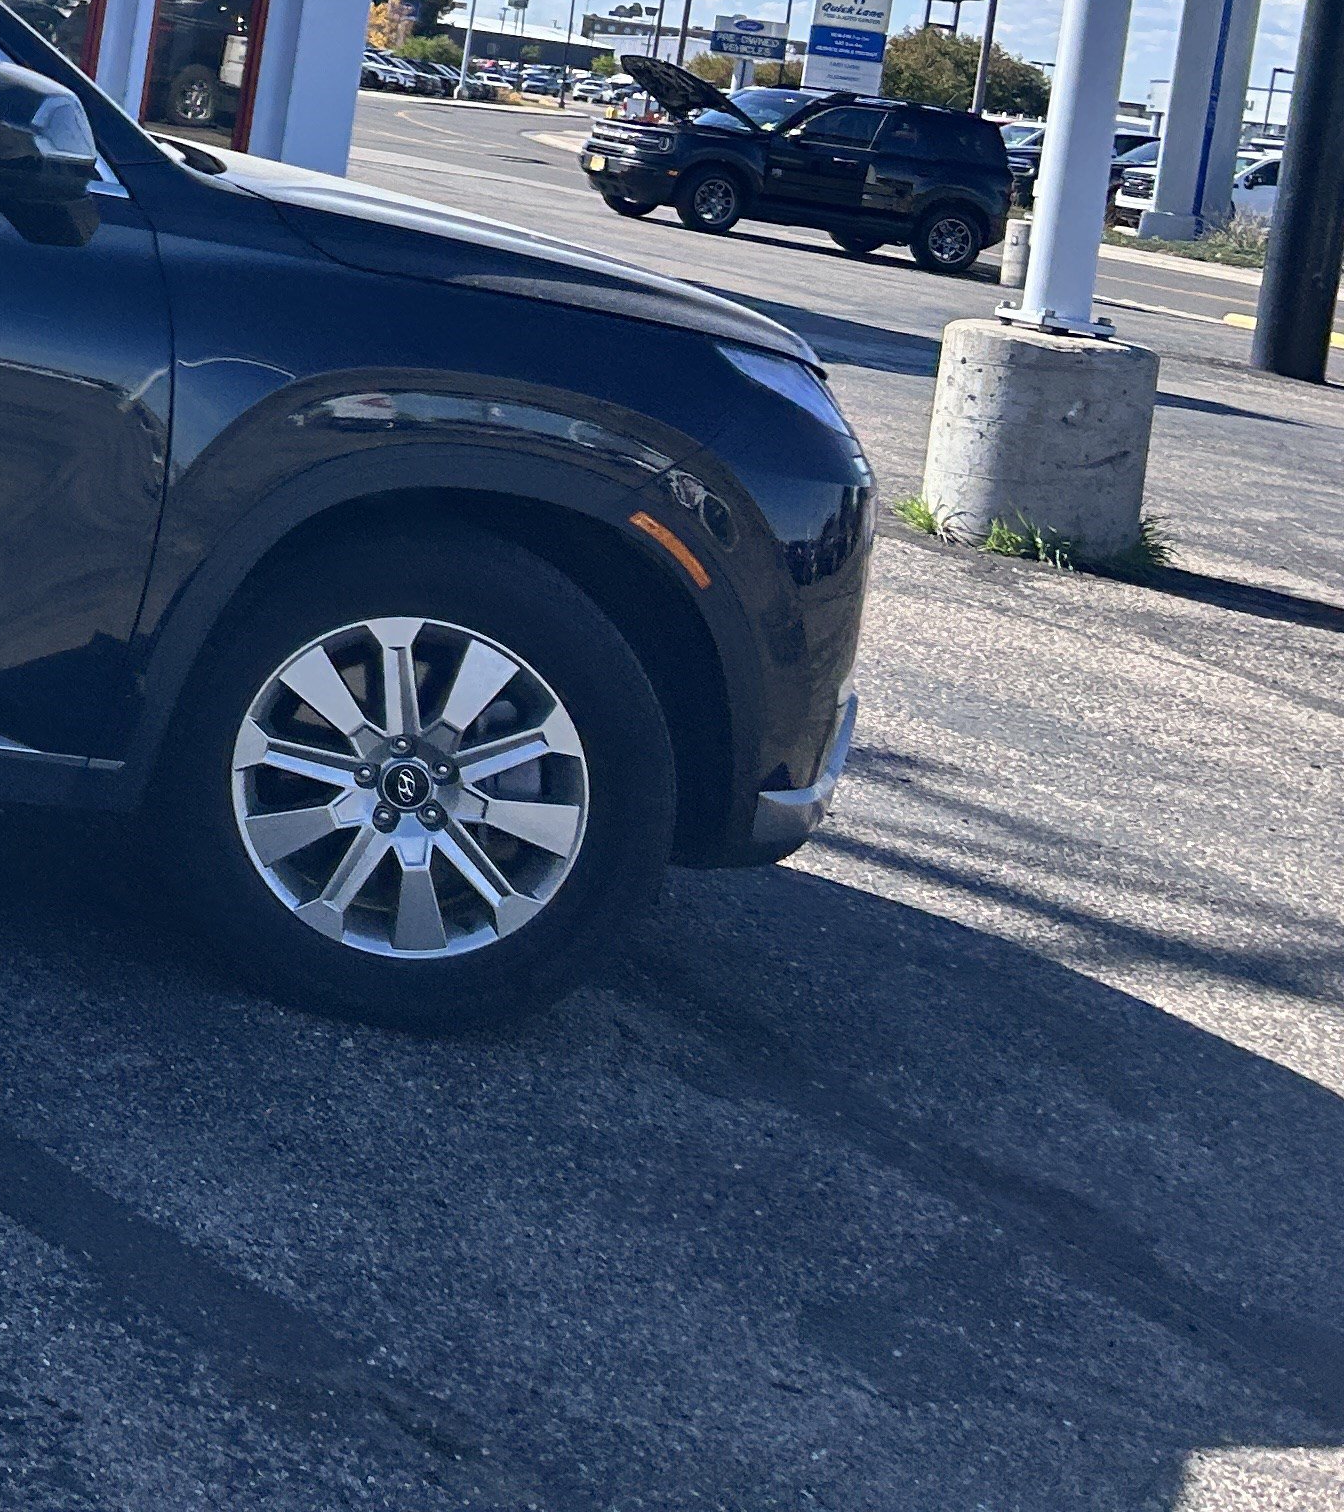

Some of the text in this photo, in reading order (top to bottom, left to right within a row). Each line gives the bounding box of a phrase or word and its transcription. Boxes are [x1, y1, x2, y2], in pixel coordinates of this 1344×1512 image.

[821, 2, 885, 18] Quick Lane
[722, 42, 772, 57] VEHICLES
